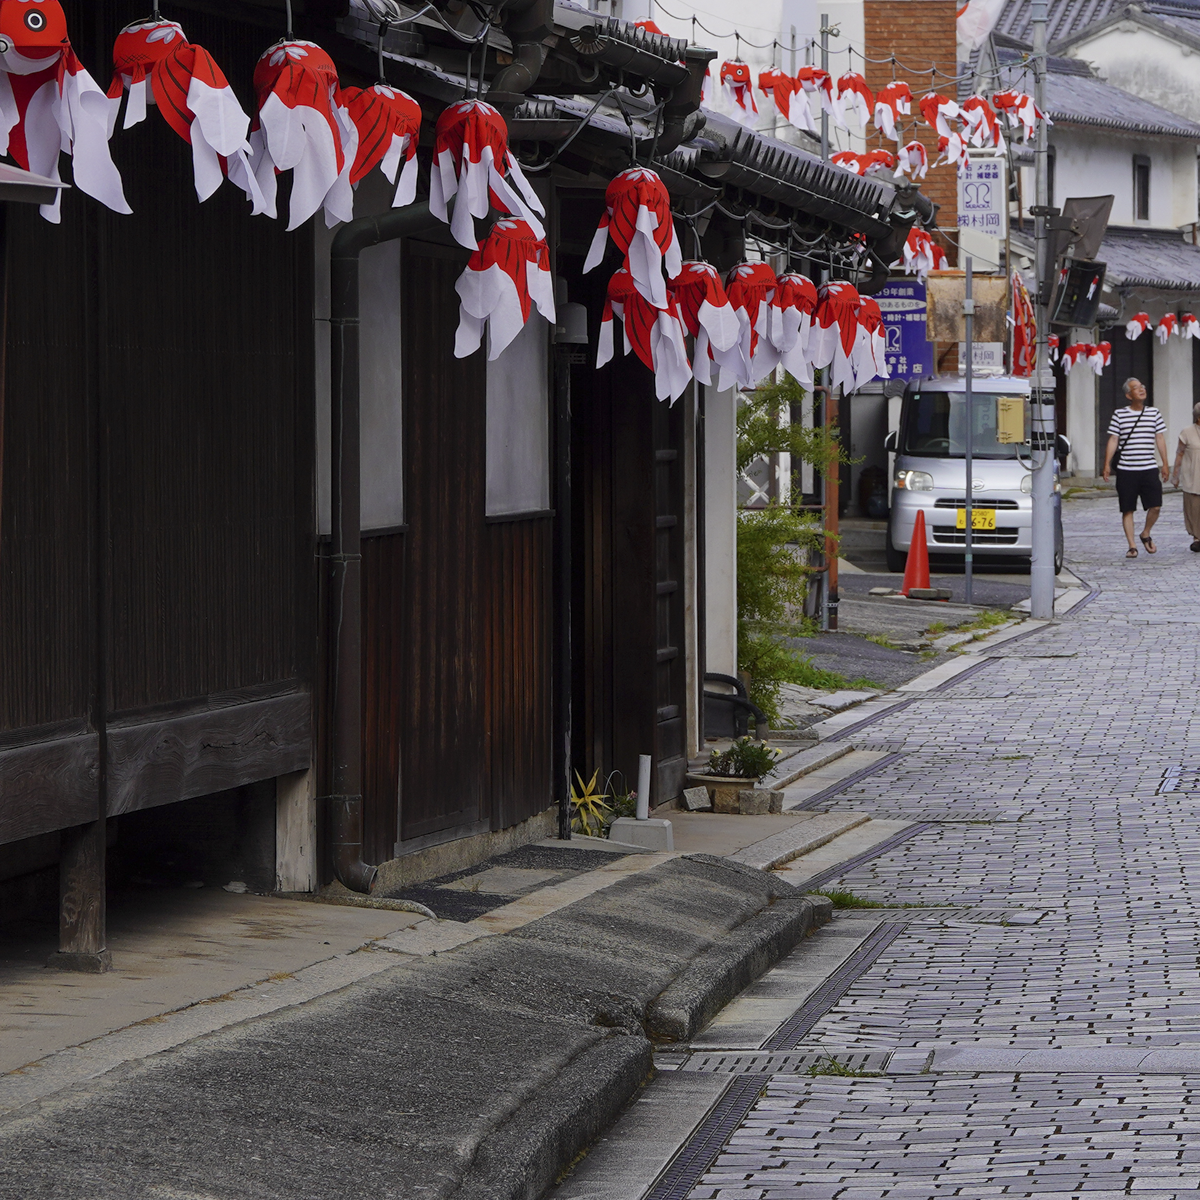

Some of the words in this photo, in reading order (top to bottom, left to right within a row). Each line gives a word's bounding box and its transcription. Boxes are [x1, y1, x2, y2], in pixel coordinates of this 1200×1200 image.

[977, 163, 998, 171] メガネ
[877, 301, 920, 309] のあるものを
[885, 356, 907, 364] 会社
